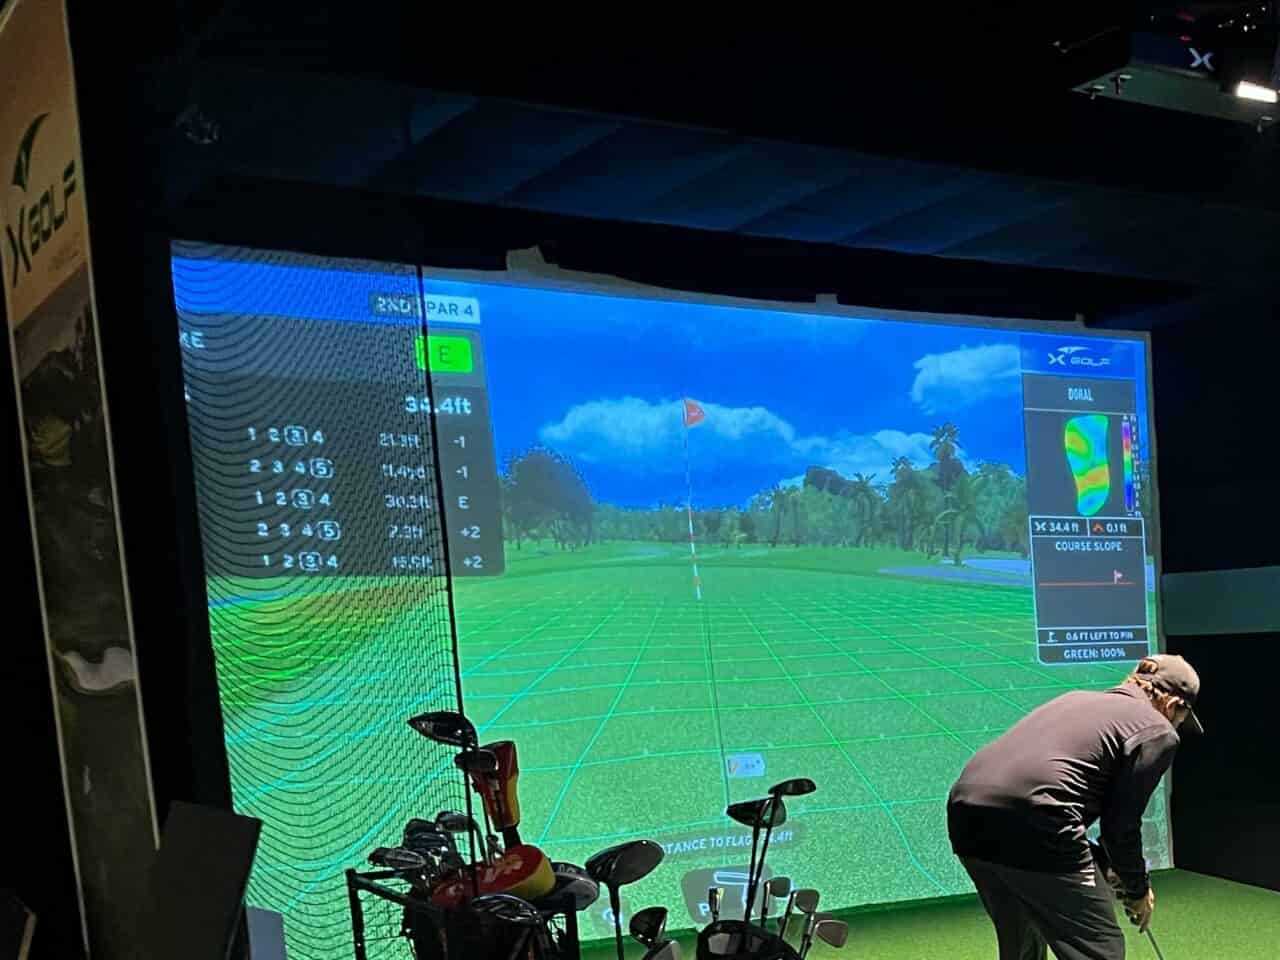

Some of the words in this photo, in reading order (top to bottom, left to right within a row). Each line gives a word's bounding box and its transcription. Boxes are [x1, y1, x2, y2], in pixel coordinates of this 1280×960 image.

[427, 302, 459, 316] PAR
[464, 304, 474, 316] 4
[440, 345, 452, 364] E
[405, 396, 472, 414] 34.4ft
[268, 427, 280, 442] 2
[312, 430, 324, 444] 4
[453, 436, 466, 448] -1
[250, 460, 261, 473] 2
[273, 460, 284, 473] 3
[456, 466, 468, 478] -1
[276, 491, 287, 505] 2
[320, 493, 331, 506] 4
[458, 496, 470, 509] E
[257, 523, 268, 536] 2
[280, 523, 291, 536] 3
[302, 524, 313, 537] 4
[461, 526, 481, 538] +2
[1049, 522, 1070, 532] 34.4
[1055, 541, 1092, 551] COURSE
[1094, 541, 1122, 551] SLOPE
[284, 555, 295, 568] 2
[327, 555, 338, 568] 4
[464, 556, 483, 568] +2
[1109, 632, 1119, 640] TO
[1064, 648, 1098, 659] GREEN:
[1100, 648, 1126, 658] 100%
[664, 838, 706, 855] TANCE
[711, 836, 723, 848] TO
